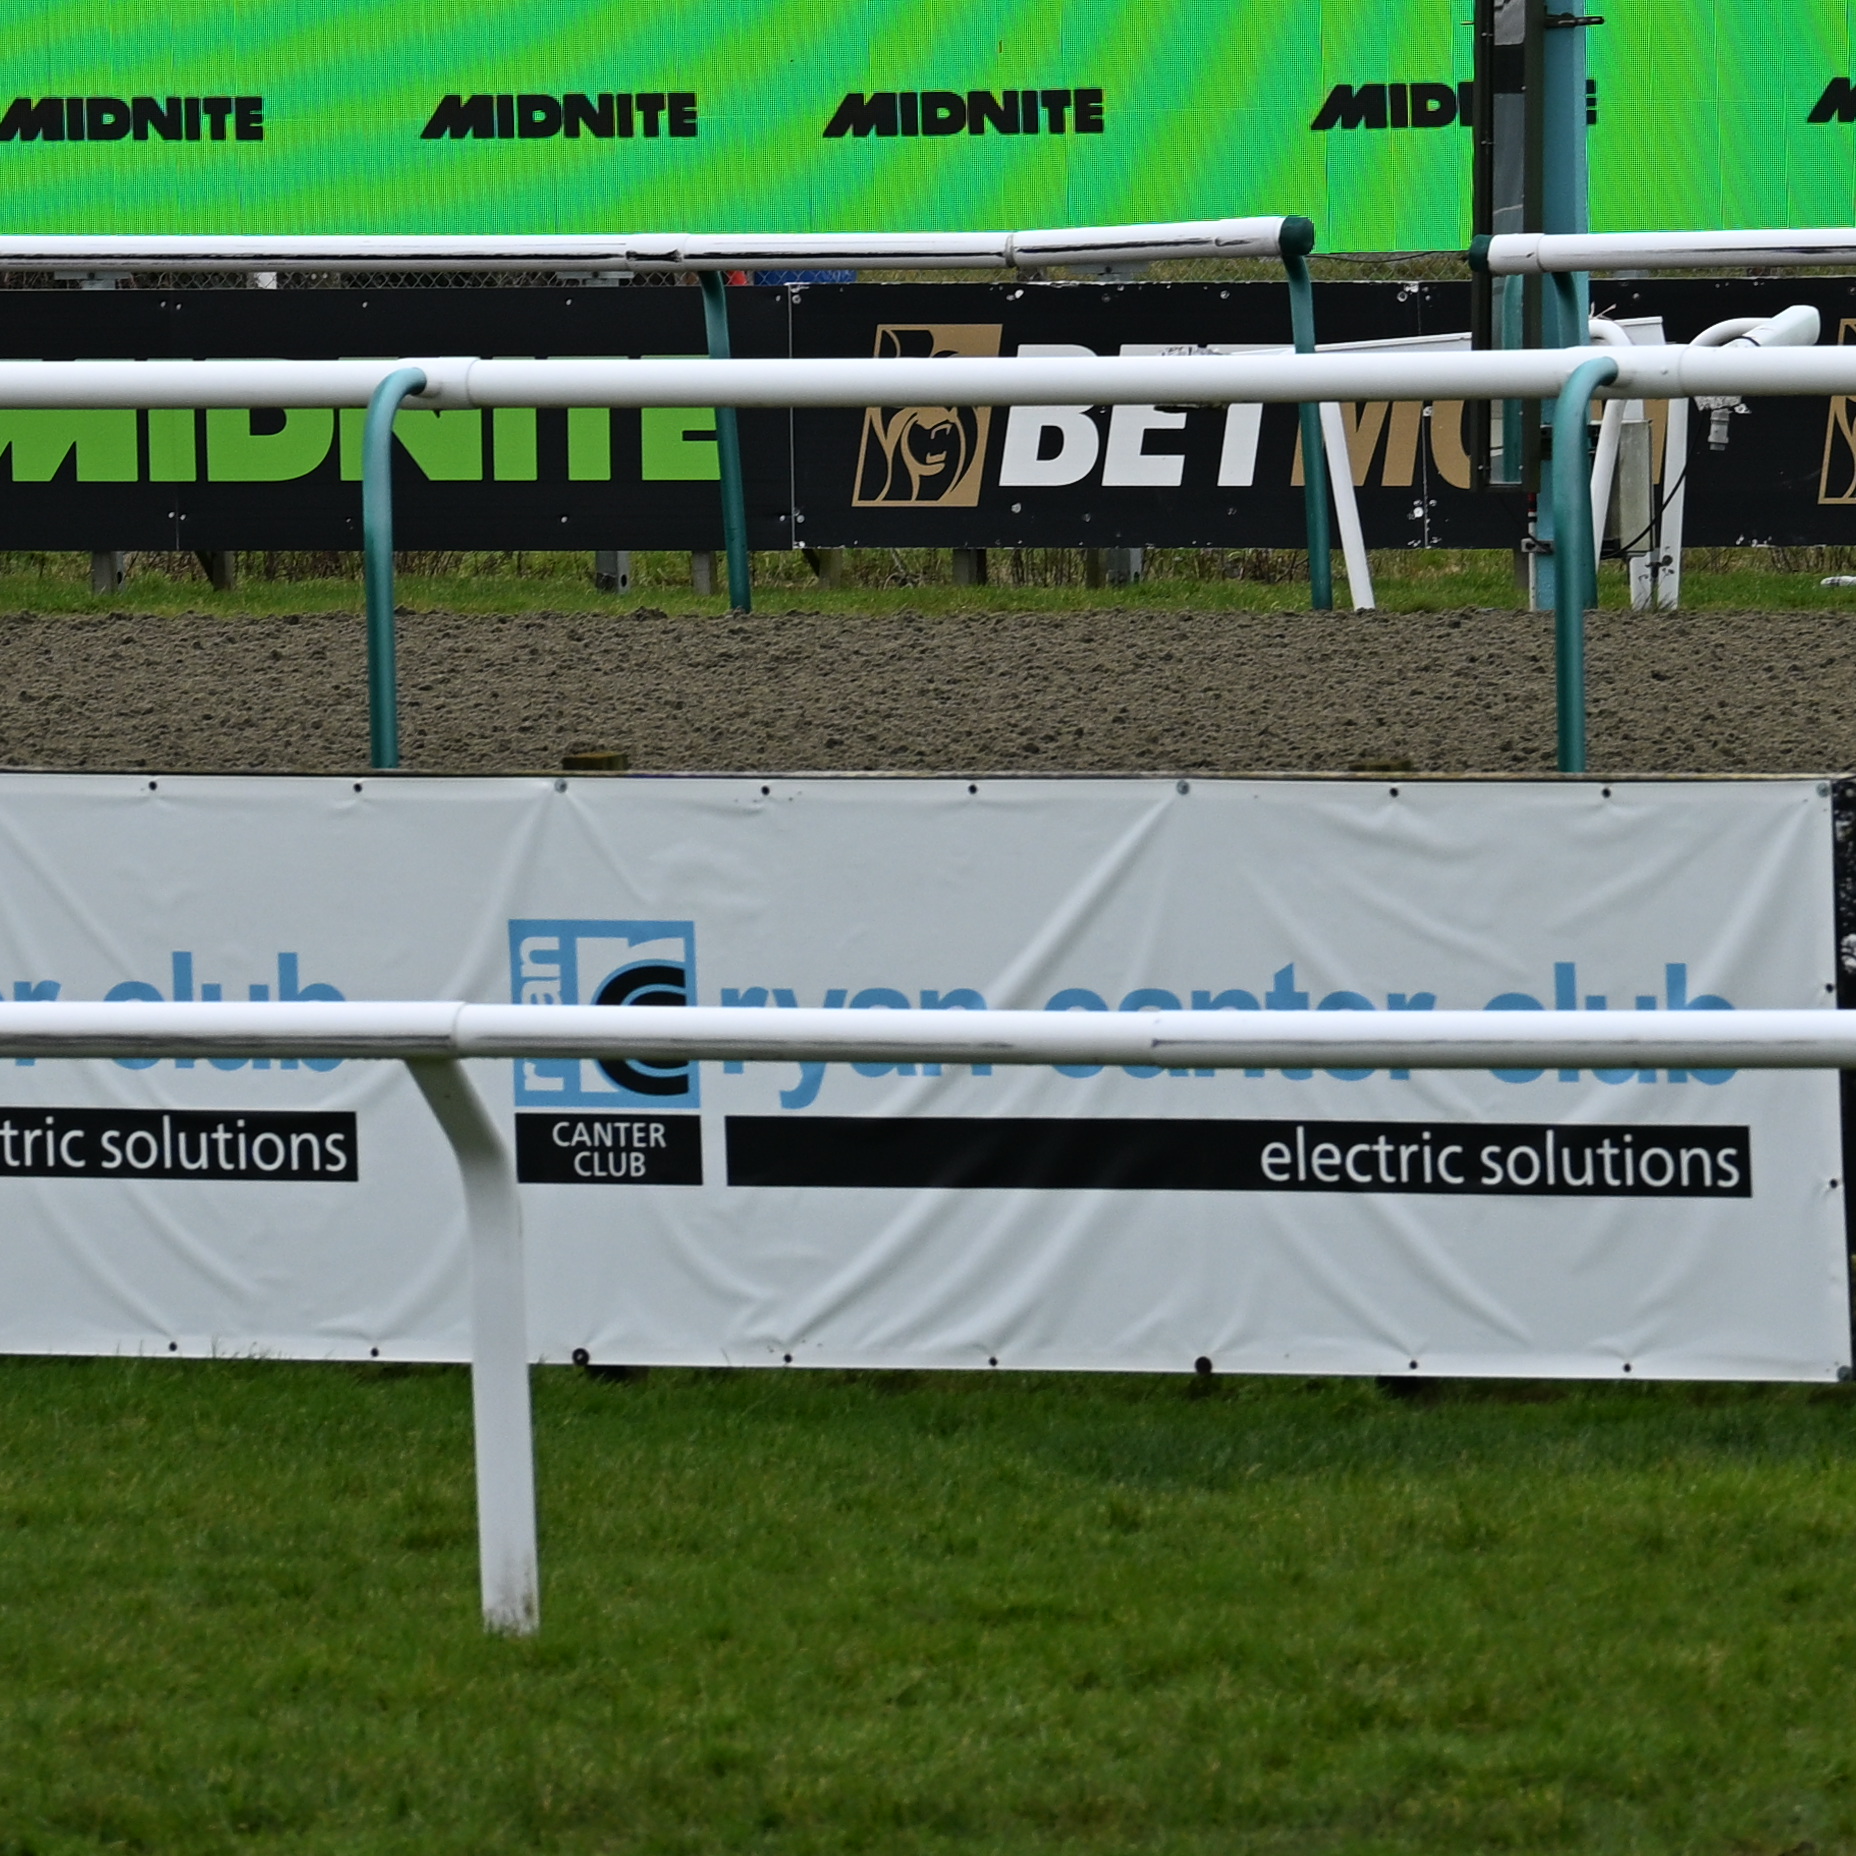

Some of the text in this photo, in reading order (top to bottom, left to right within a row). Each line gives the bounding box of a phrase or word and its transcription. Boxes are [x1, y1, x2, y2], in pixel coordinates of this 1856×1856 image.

[420, 91, 698, 140] MIDNITE
[823, 87, 1104, 138] MIDNITE
[100, 1114, 348, 1172] solutions
[552, 1121, 667, 1148] CANTER
[1260, 1125, 1741, 1189] electric solutions
[573, 1150, 647, 1178] CLUB
